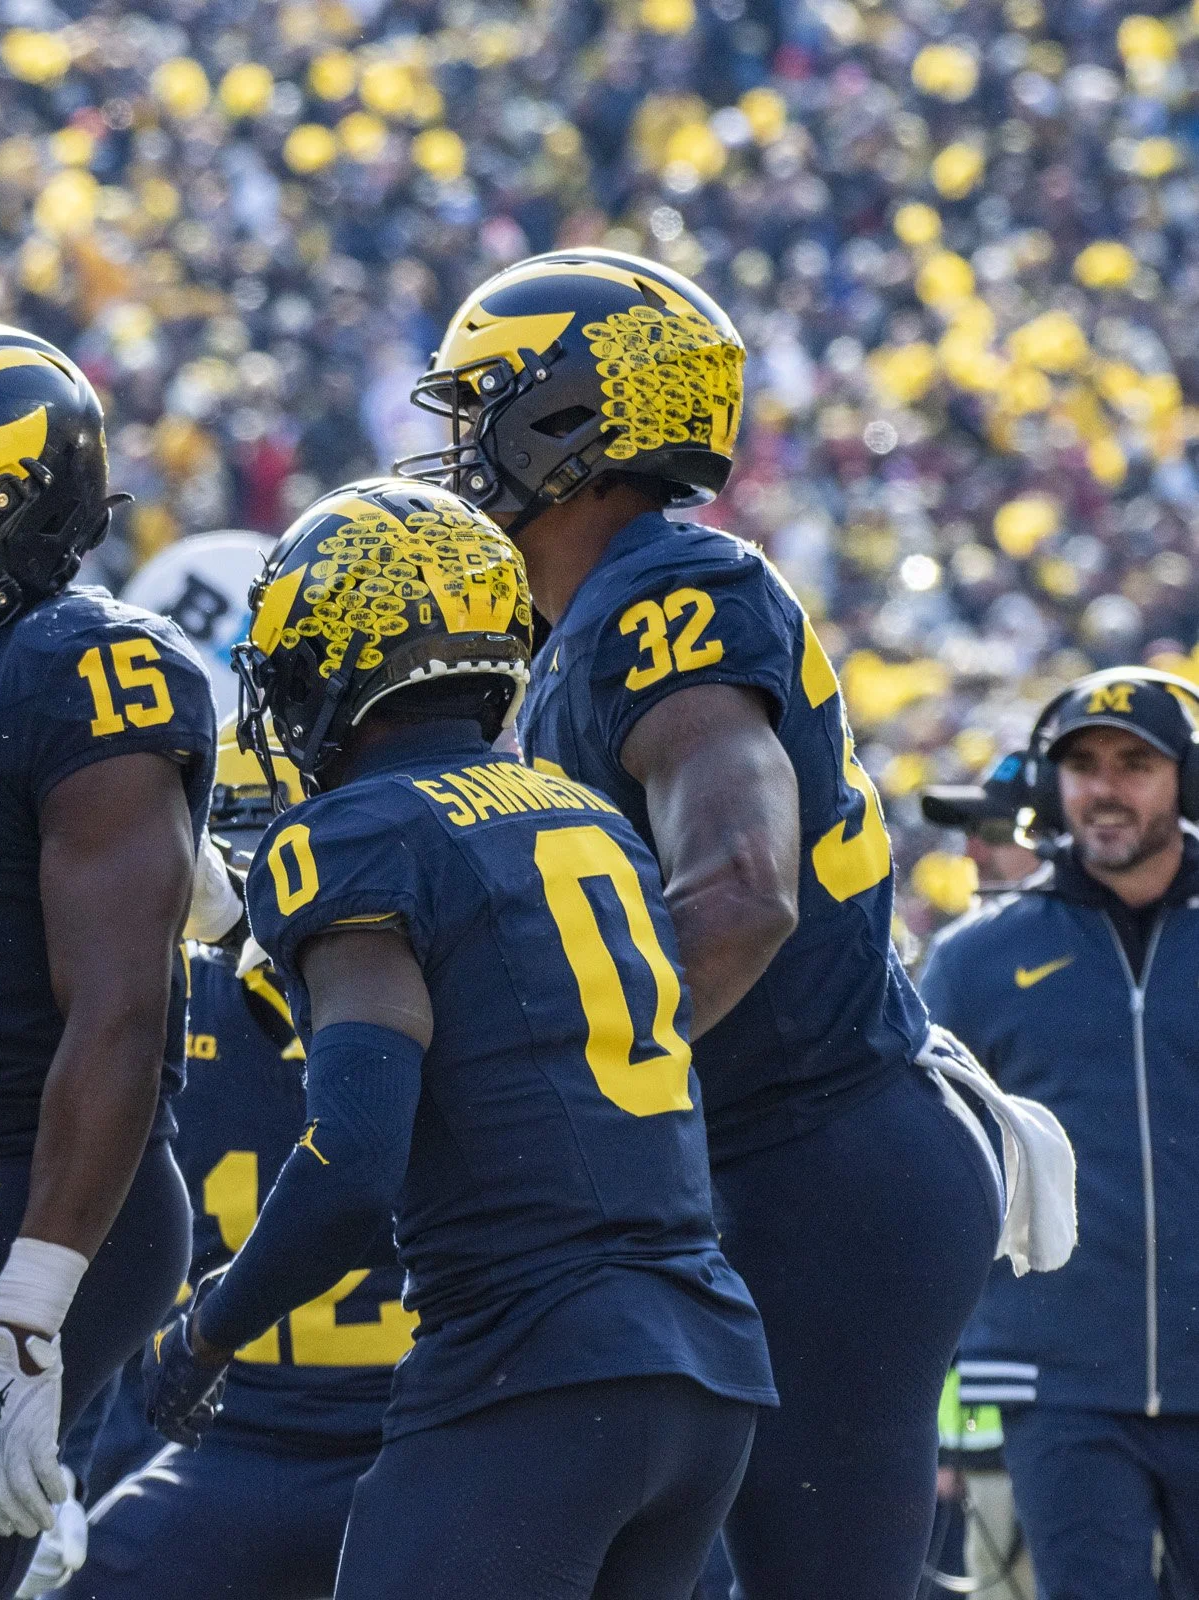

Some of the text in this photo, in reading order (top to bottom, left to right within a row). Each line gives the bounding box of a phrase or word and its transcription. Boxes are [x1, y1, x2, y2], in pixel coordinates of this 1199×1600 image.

[691, 421, 711, 444] 32
[358, 536, 381, 545] TED
[466, 553, 482, 565] C
[158, 571, 230, 642] B
[350, 612, 370, 621] GAME
[419, 602, 431, 624] 0
[619, 587, 724, 692] 32
[77, 637, 175, 737] 15
[1087, 683, 1136, 714] M
[267, 823, 320, 916] 0
[534, 825, 693, 1118] 0
